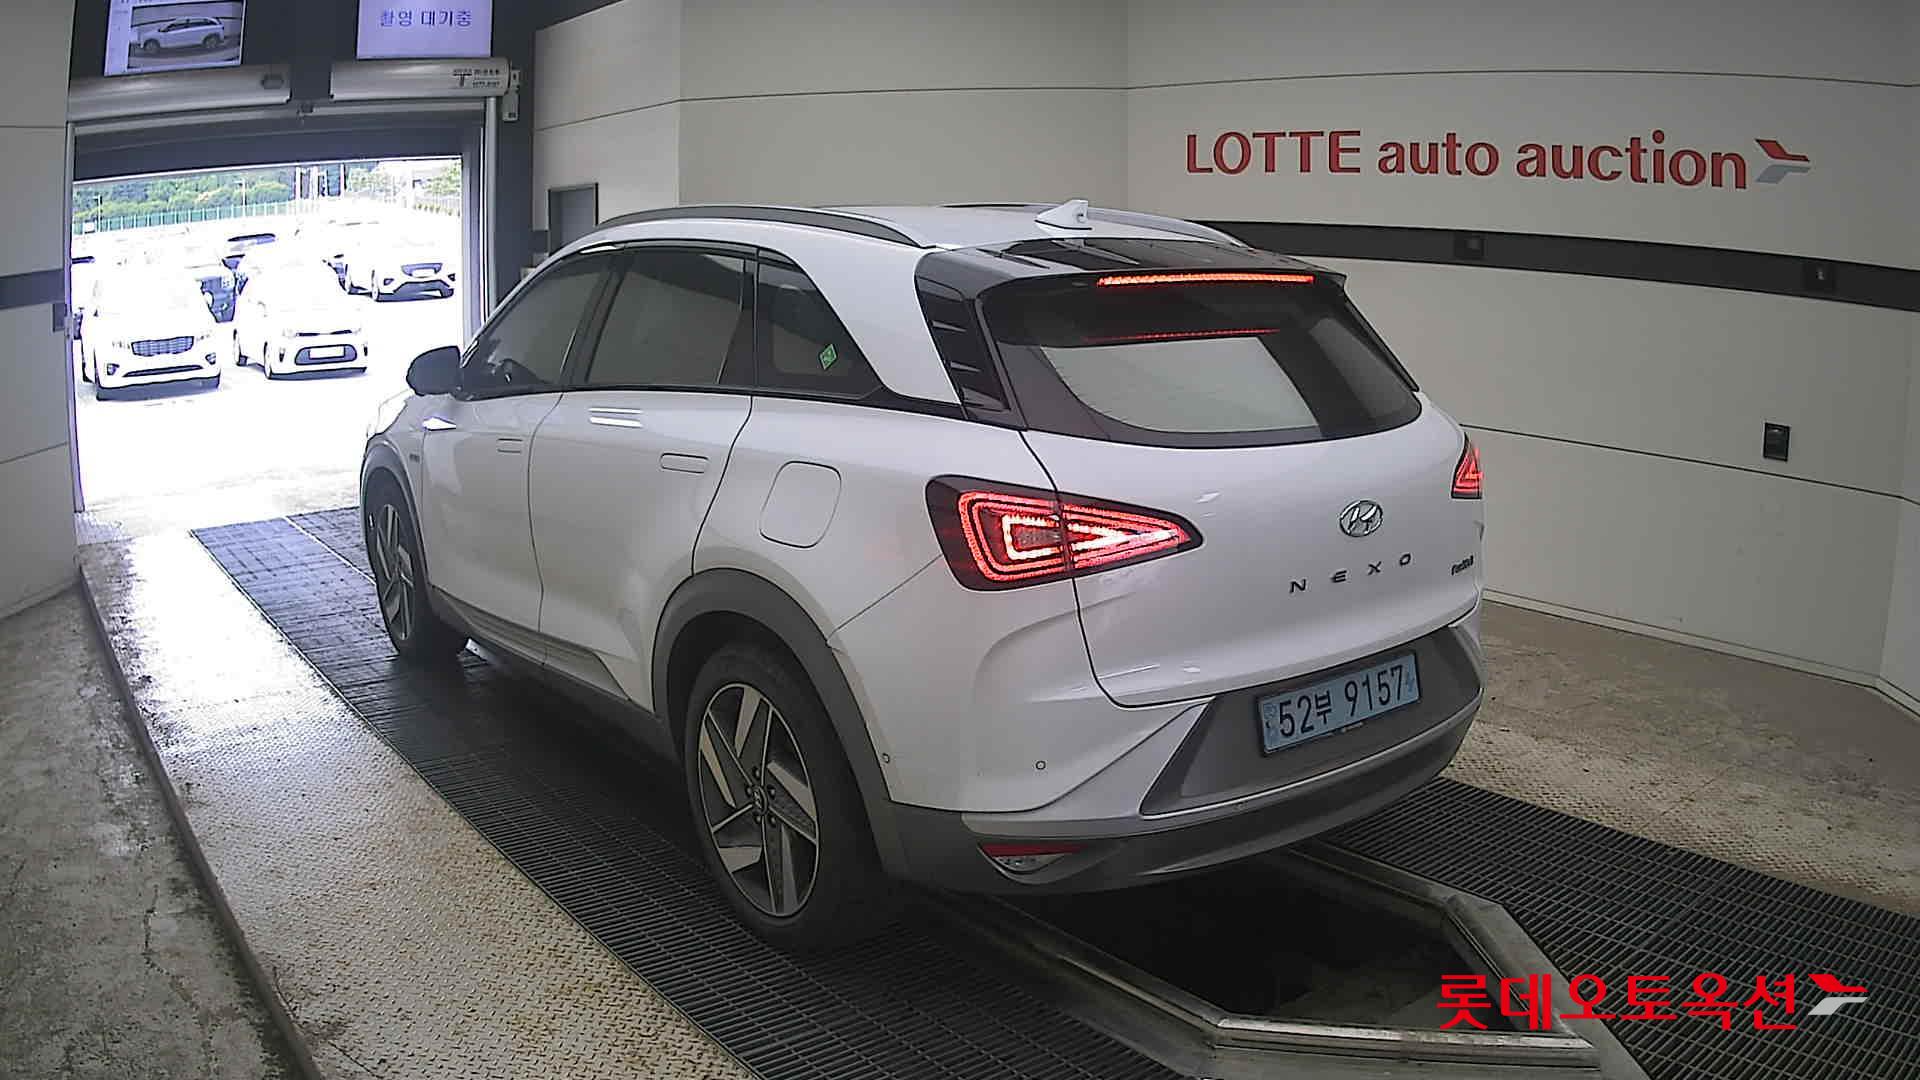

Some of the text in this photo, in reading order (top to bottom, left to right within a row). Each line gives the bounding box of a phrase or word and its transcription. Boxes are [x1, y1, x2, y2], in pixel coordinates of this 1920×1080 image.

[421, 10, 473, 27] 대기중
[1186, 129, 1747, 190] LOTTE auto auction
[1289, 553, 1412, 594] NEXO
[1279, 664, 1404, 737] 52부 9157
